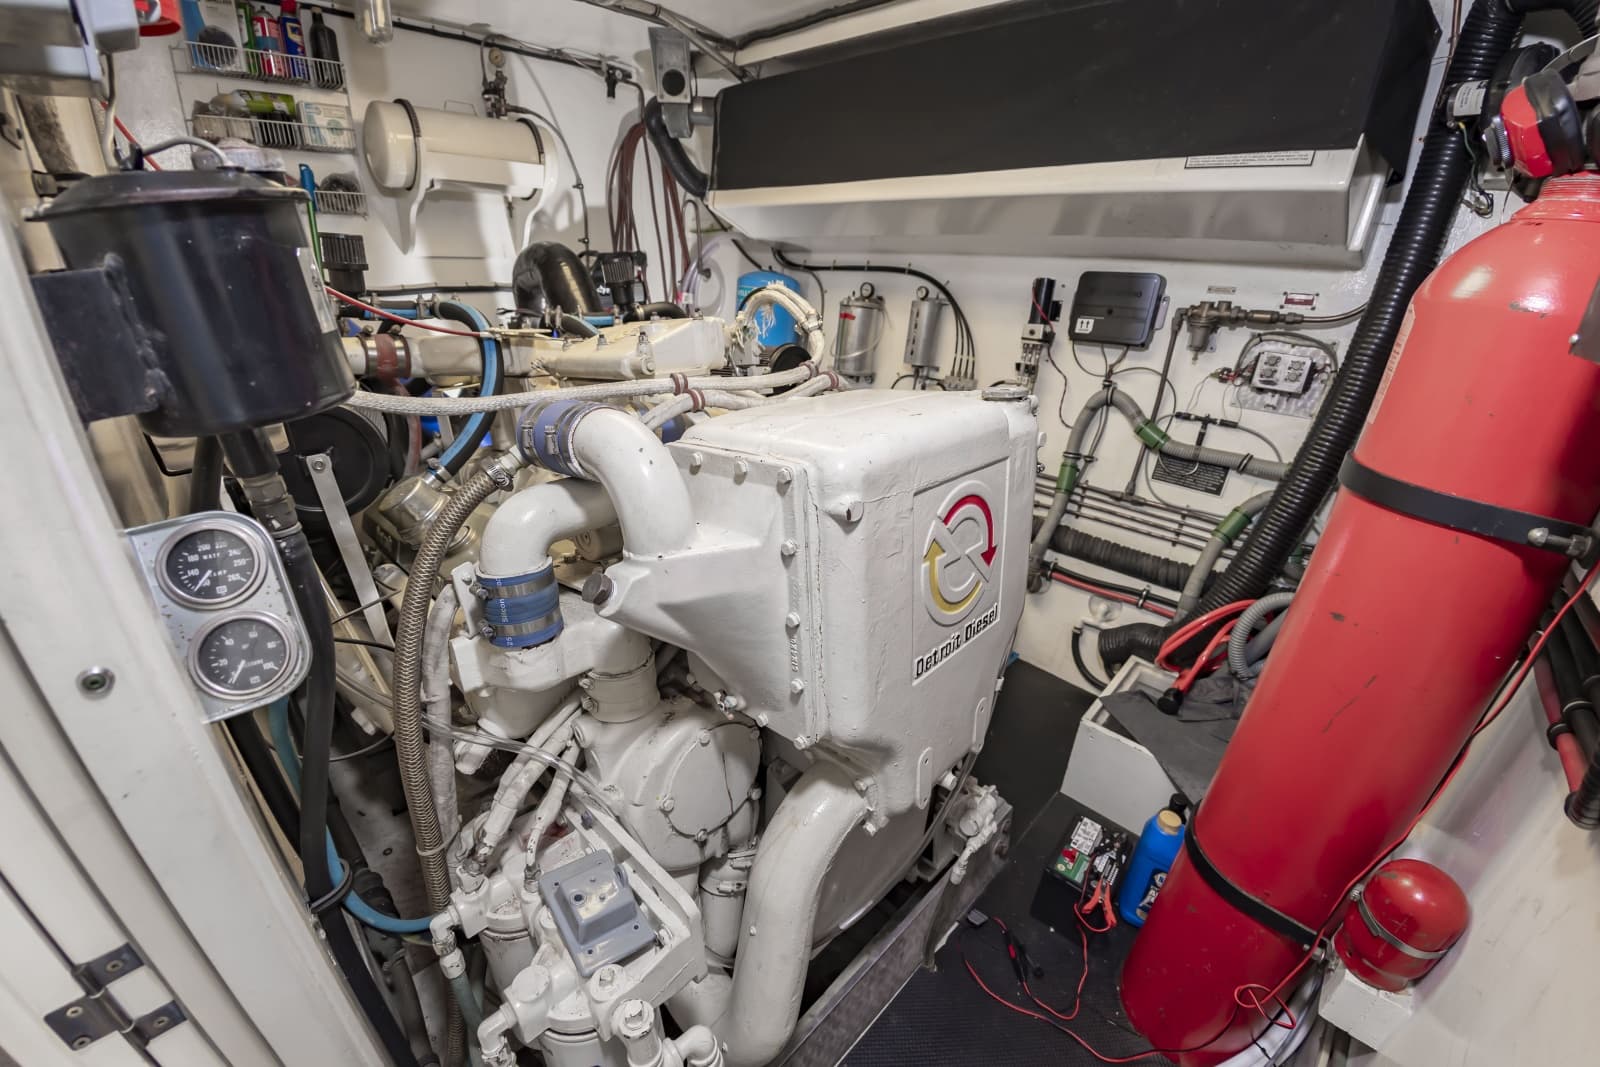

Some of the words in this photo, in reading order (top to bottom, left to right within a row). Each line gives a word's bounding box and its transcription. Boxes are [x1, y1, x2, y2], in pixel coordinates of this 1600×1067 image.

[187, 568, 200, 577] 140
[914, 634, 961, 680] Detroit
[964, 603, 998, 642] Diesel
